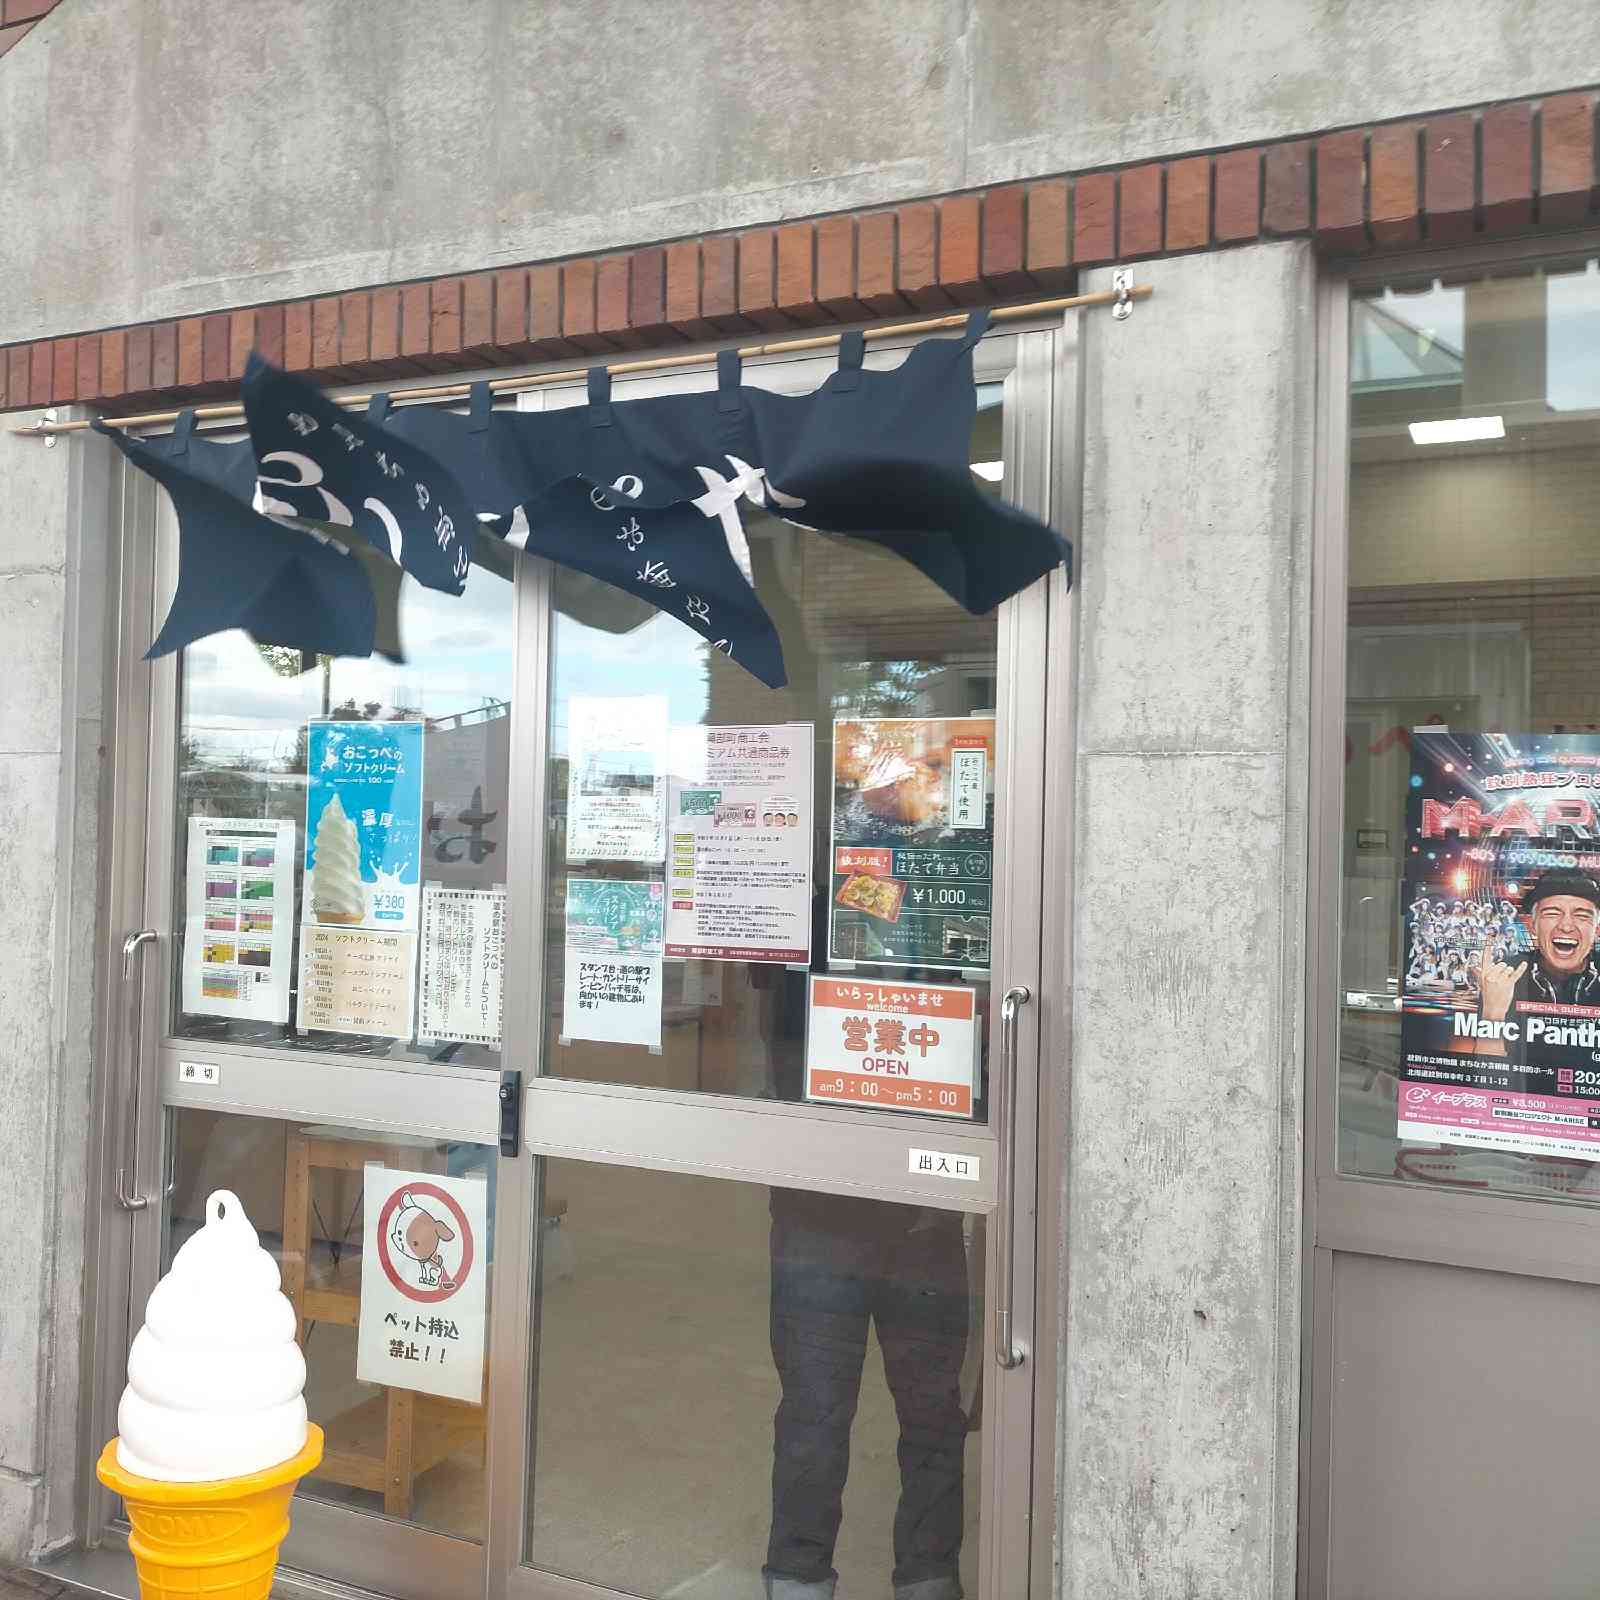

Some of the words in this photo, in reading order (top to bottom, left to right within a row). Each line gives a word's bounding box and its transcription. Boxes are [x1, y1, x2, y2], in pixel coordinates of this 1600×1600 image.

[344, 762, 405, 774] ソフトクリーム
[362, 808, 394, 828] 濃厚
[896, 862, 960, 875] ほたて弁当
[373, 894, 405, 909] ¥380
[837, 986, 944, 1007] いらっしゃいませ
[866, 1002, 909, 1013] welcome
[1520, 1003, 1557, 1014] SPECIAL
[1561, 1006, 1591, 1016] GUEST
[1454, 1012, 1521, 1041] Marc
[842, 1015, 941, 1058] 営業中
[862, 1057, 910, 1076] OPEN
[1512, 1064, 1555, 1076] 多目的ホール
[1432, 1091, 1488, 1108] イープラス
[919, 1154, 968, 1175] 出入口
[384, 1311, 460, 1340] ペット持込
[389, 1337, 446, 1364] 禁止！！
